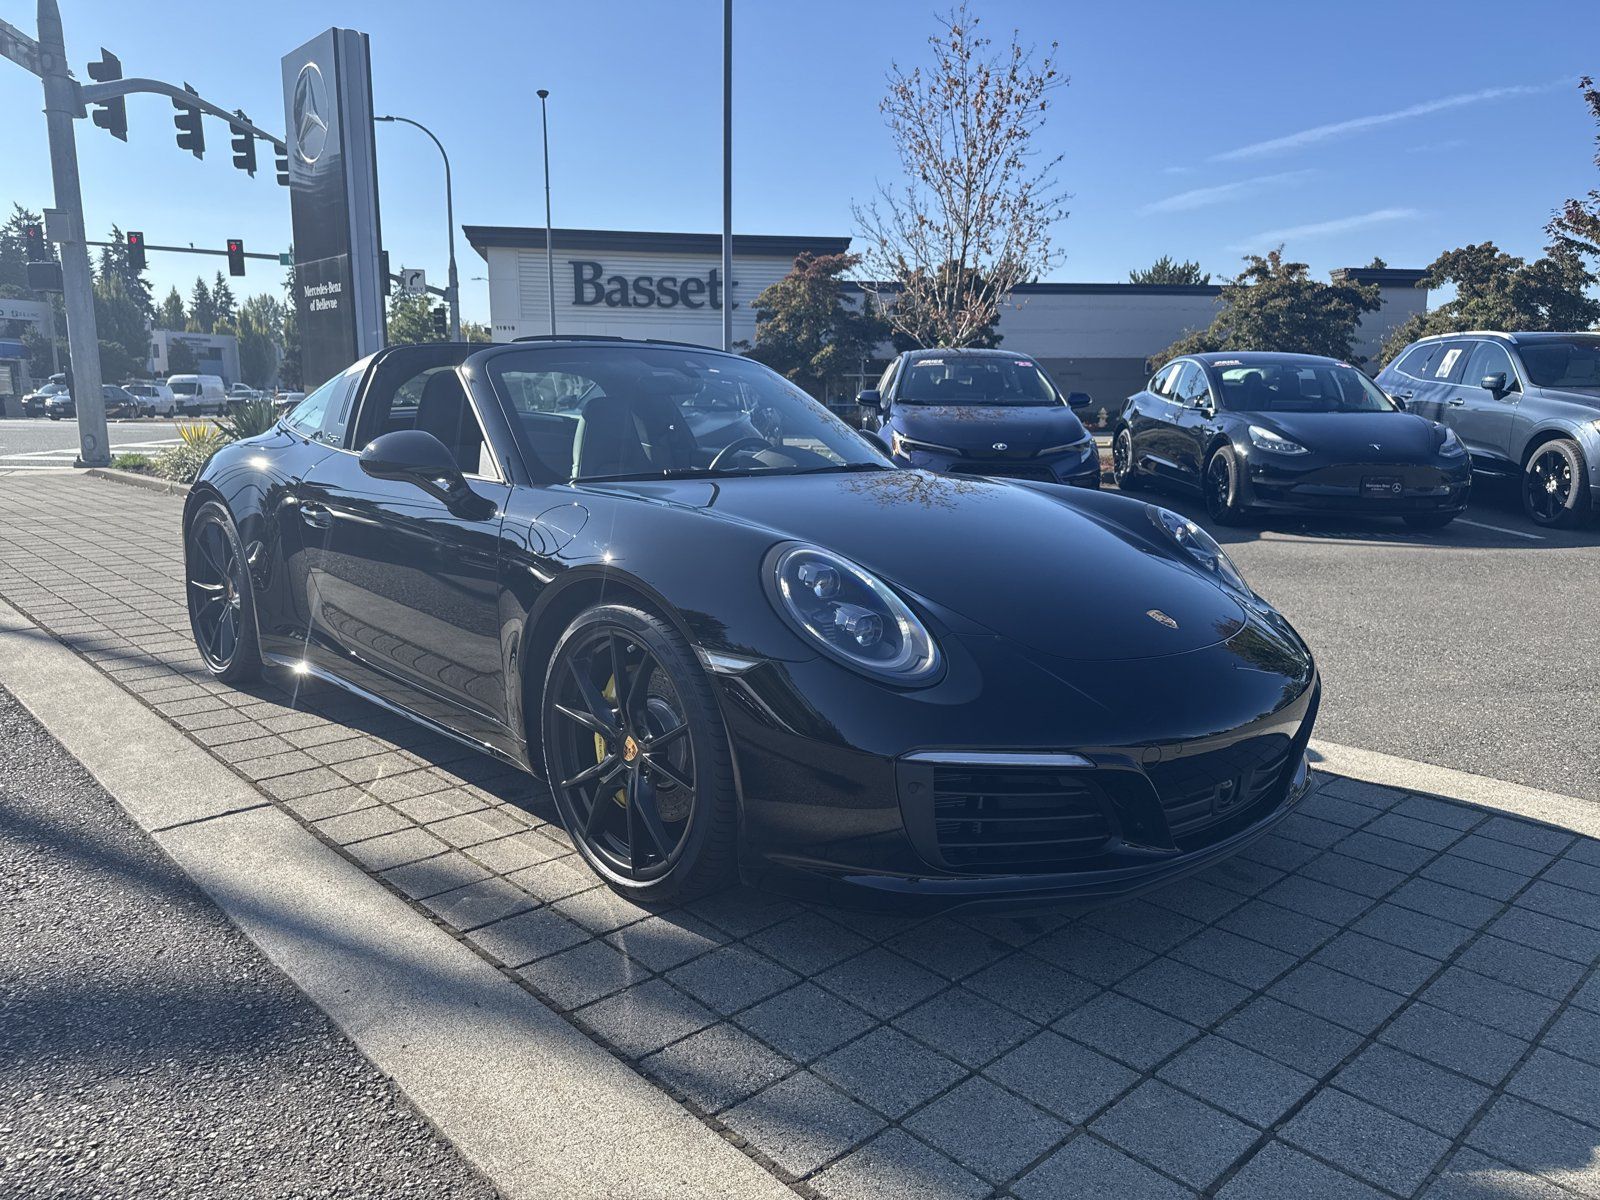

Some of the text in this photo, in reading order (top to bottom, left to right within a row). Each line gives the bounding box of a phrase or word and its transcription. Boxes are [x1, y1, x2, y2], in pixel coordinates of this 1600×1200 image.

[304, 281, 342, 297] Mercedes-Benz
[310, 298, 338, 311] of Bellevue
